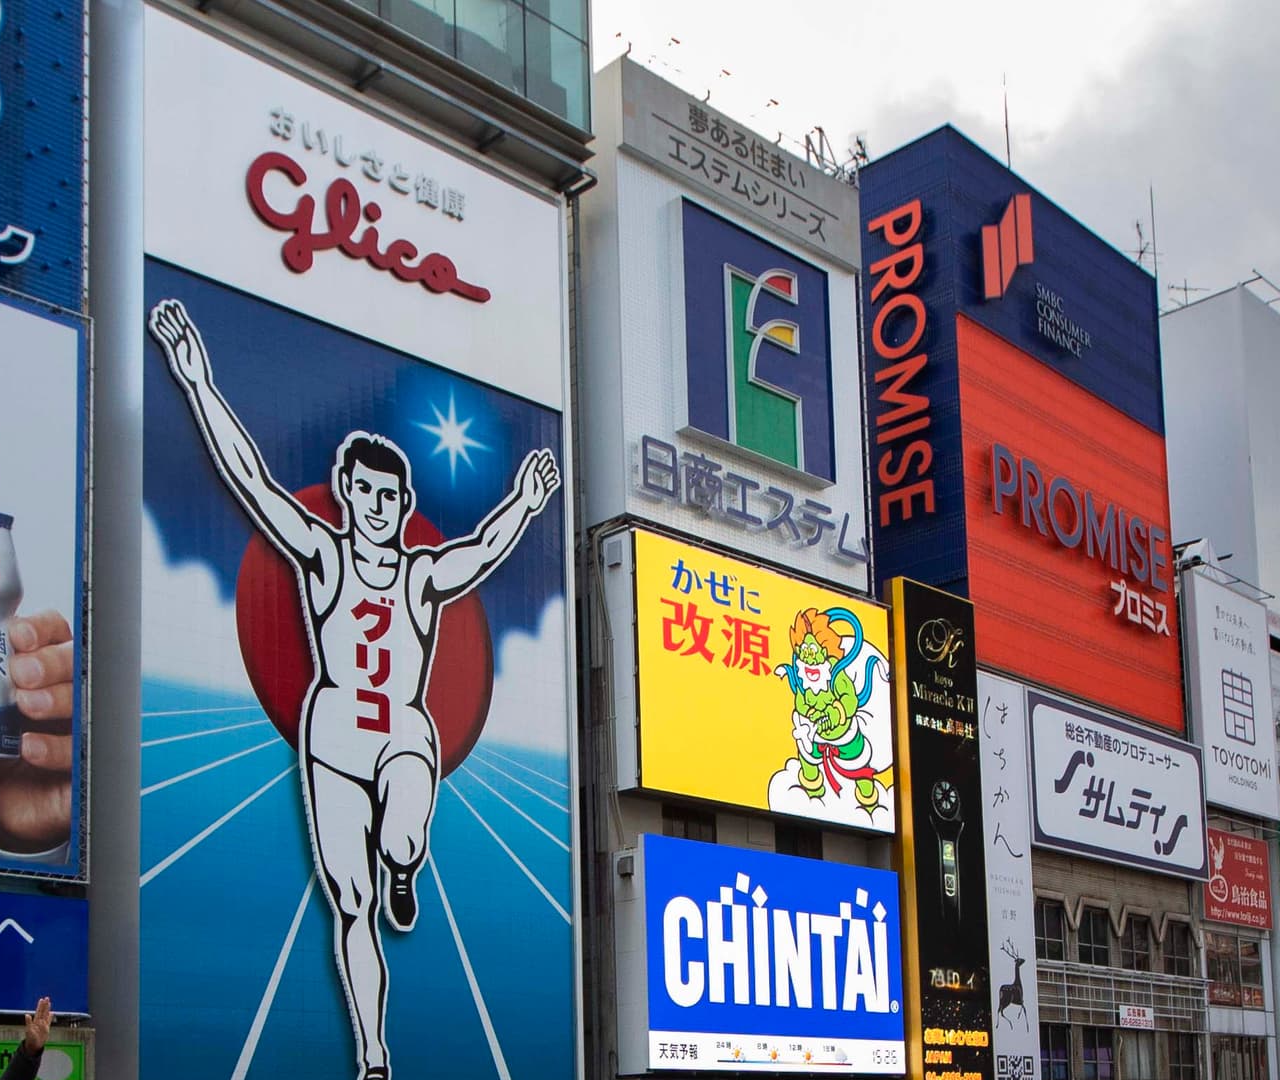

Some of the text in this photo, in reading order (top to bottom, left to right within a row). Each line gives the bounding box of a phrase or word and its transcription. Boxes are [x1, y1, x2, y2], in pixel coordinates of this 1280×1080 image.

[268, 105, 466, 222] おいしさと健康
[686, 102, 808, 191] 夢ある住まい
[246, 150, 492, 274] Glico
[666, 136, 829, 244] エステムシリーズ
[1036, 282, 1064, 313] SMBC
[1037, 300, 1092, 349] CONSUMER
[1038, 317, 1082, 358] FINANCE
[867, 197, 937, 529] PROMISE
[639, 434, 870, 567] 日商エステム
[991, 442, 1170, 592] PROMISE
[670, 558, 762, 616] かぜに
[1109, 579, 1171, 638] プロミス
[350, 596, 396, 736] グリコ
[659, 596, 773, 678] 改源
[911, 680, 955, 708] Miracle
[983, 695, 1024, 859] はちかん
[1064, 720, 1181, 770] 総合不動産のプロデューサー
[1228, 774, 1258, 791] HOLDINGS
[658, 1043, 699, 1061] 天気予報
